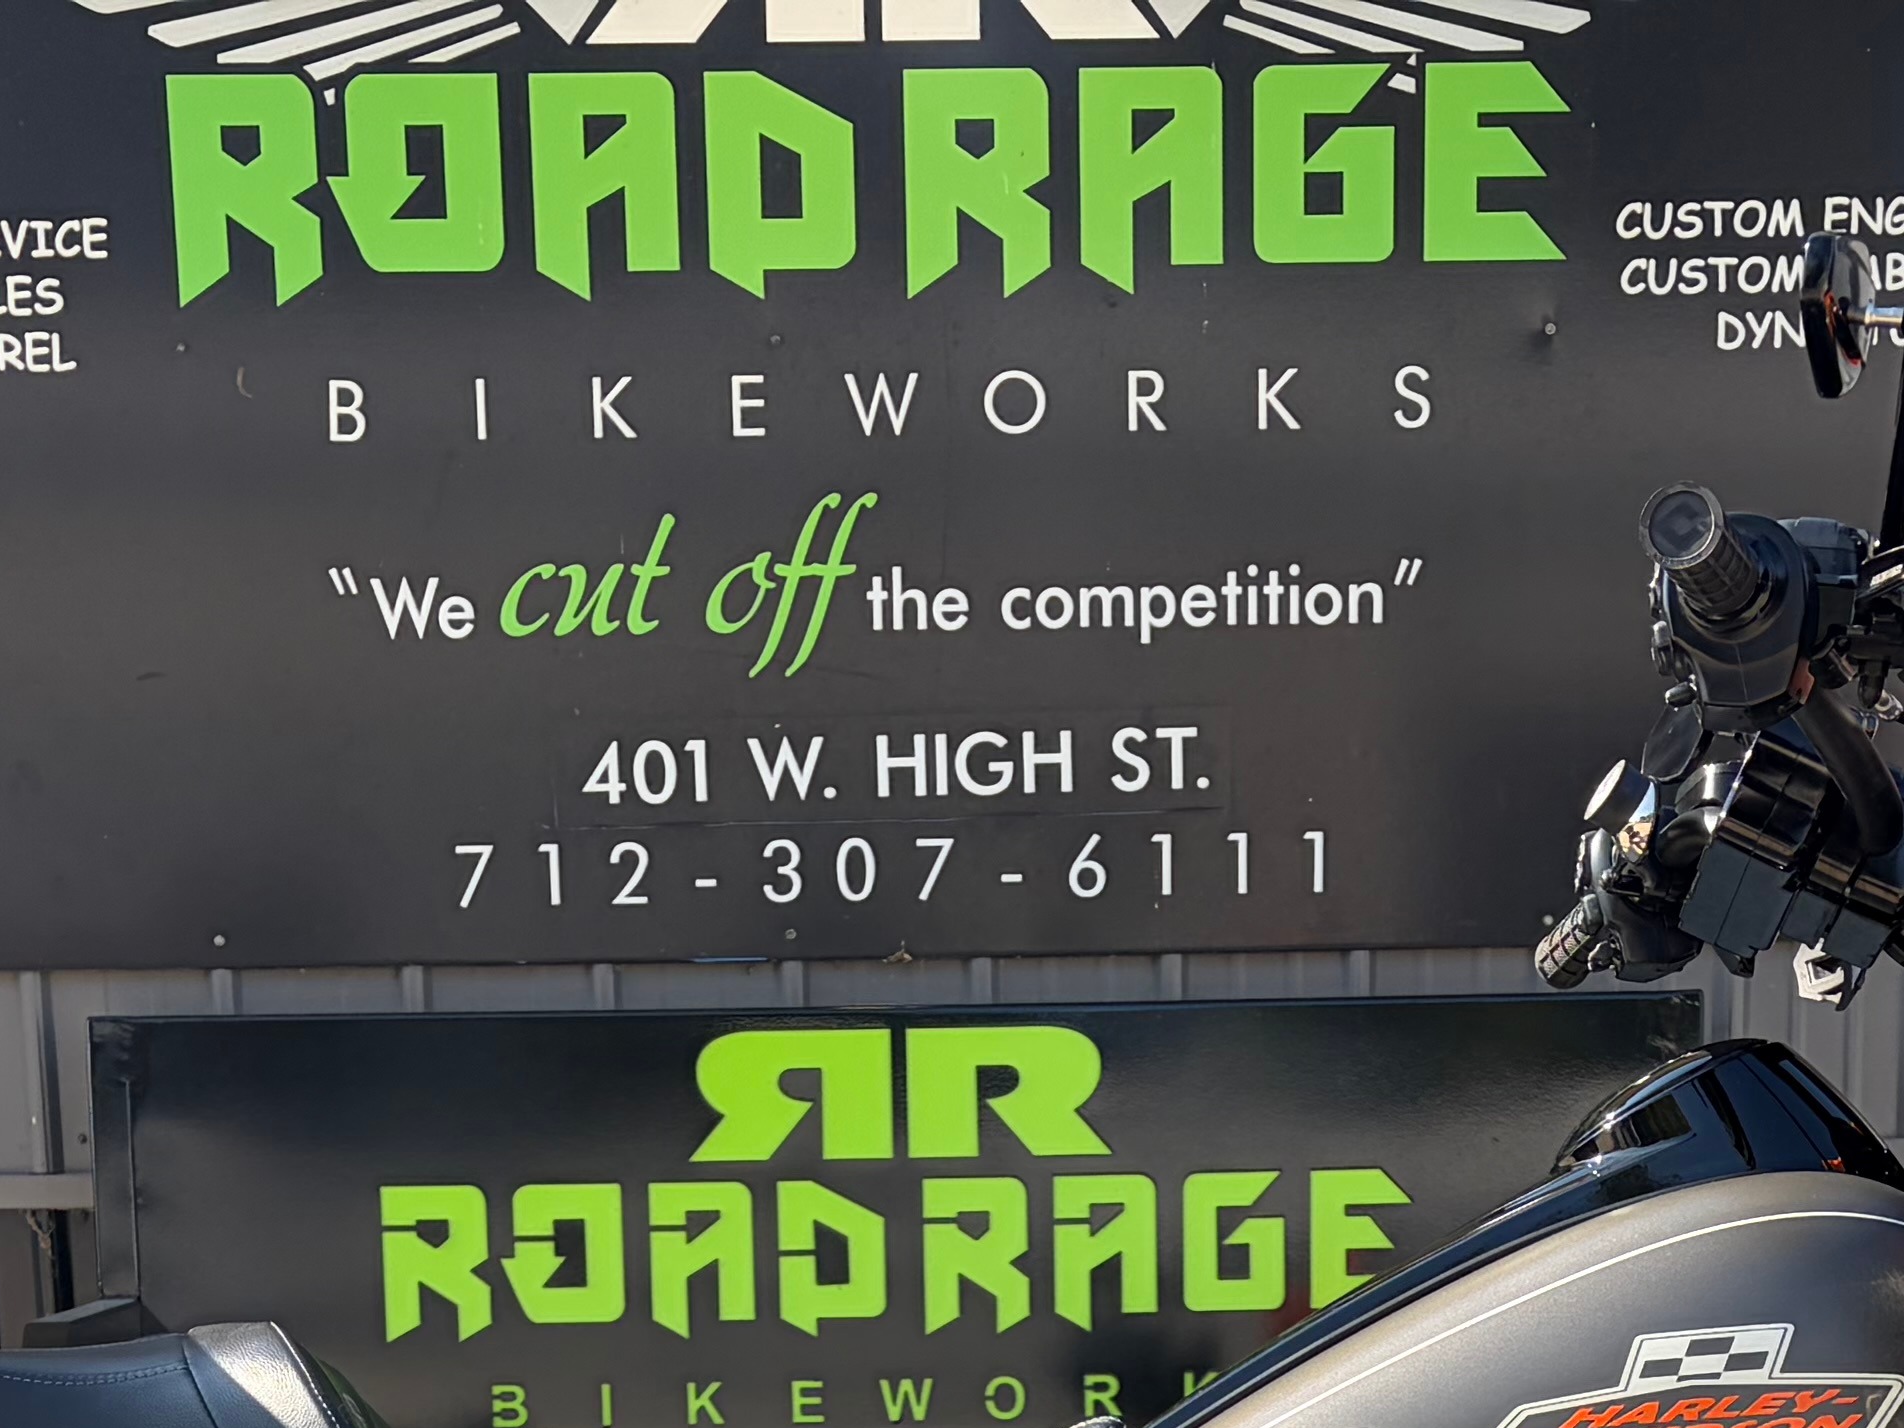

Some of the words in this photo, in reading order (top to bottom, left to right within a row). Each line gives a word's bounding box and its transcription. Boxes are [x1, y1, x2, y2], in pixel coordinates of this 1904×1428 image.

[165, 70, 858, 305] ROAD
[904, 60, 1572, 299] RAGE
[1615, 199, 1804, 239] CUSTOM
[1619, 254, 1804, 295] CUSTOM
[1716, 309, 1807, 351] DYN
[328, 364, 1436, 444] BIKEWORKS
[500, 514, 675, 638] cut
[704, 491, 879, 679] off
[866, 565, 969, 631] the
[581, 738, 709, 805] 401
[746, 735, 838, 802] W.
[875, 730, 1074, 798] HIGH
[1109, 726, 1211, 792] ST.
[379, 1180, 887, 1343] ROAD
[922, 1168, 1413, 1335] RAGE
[493, 1371, 1220, 1428] BIKEWOR
